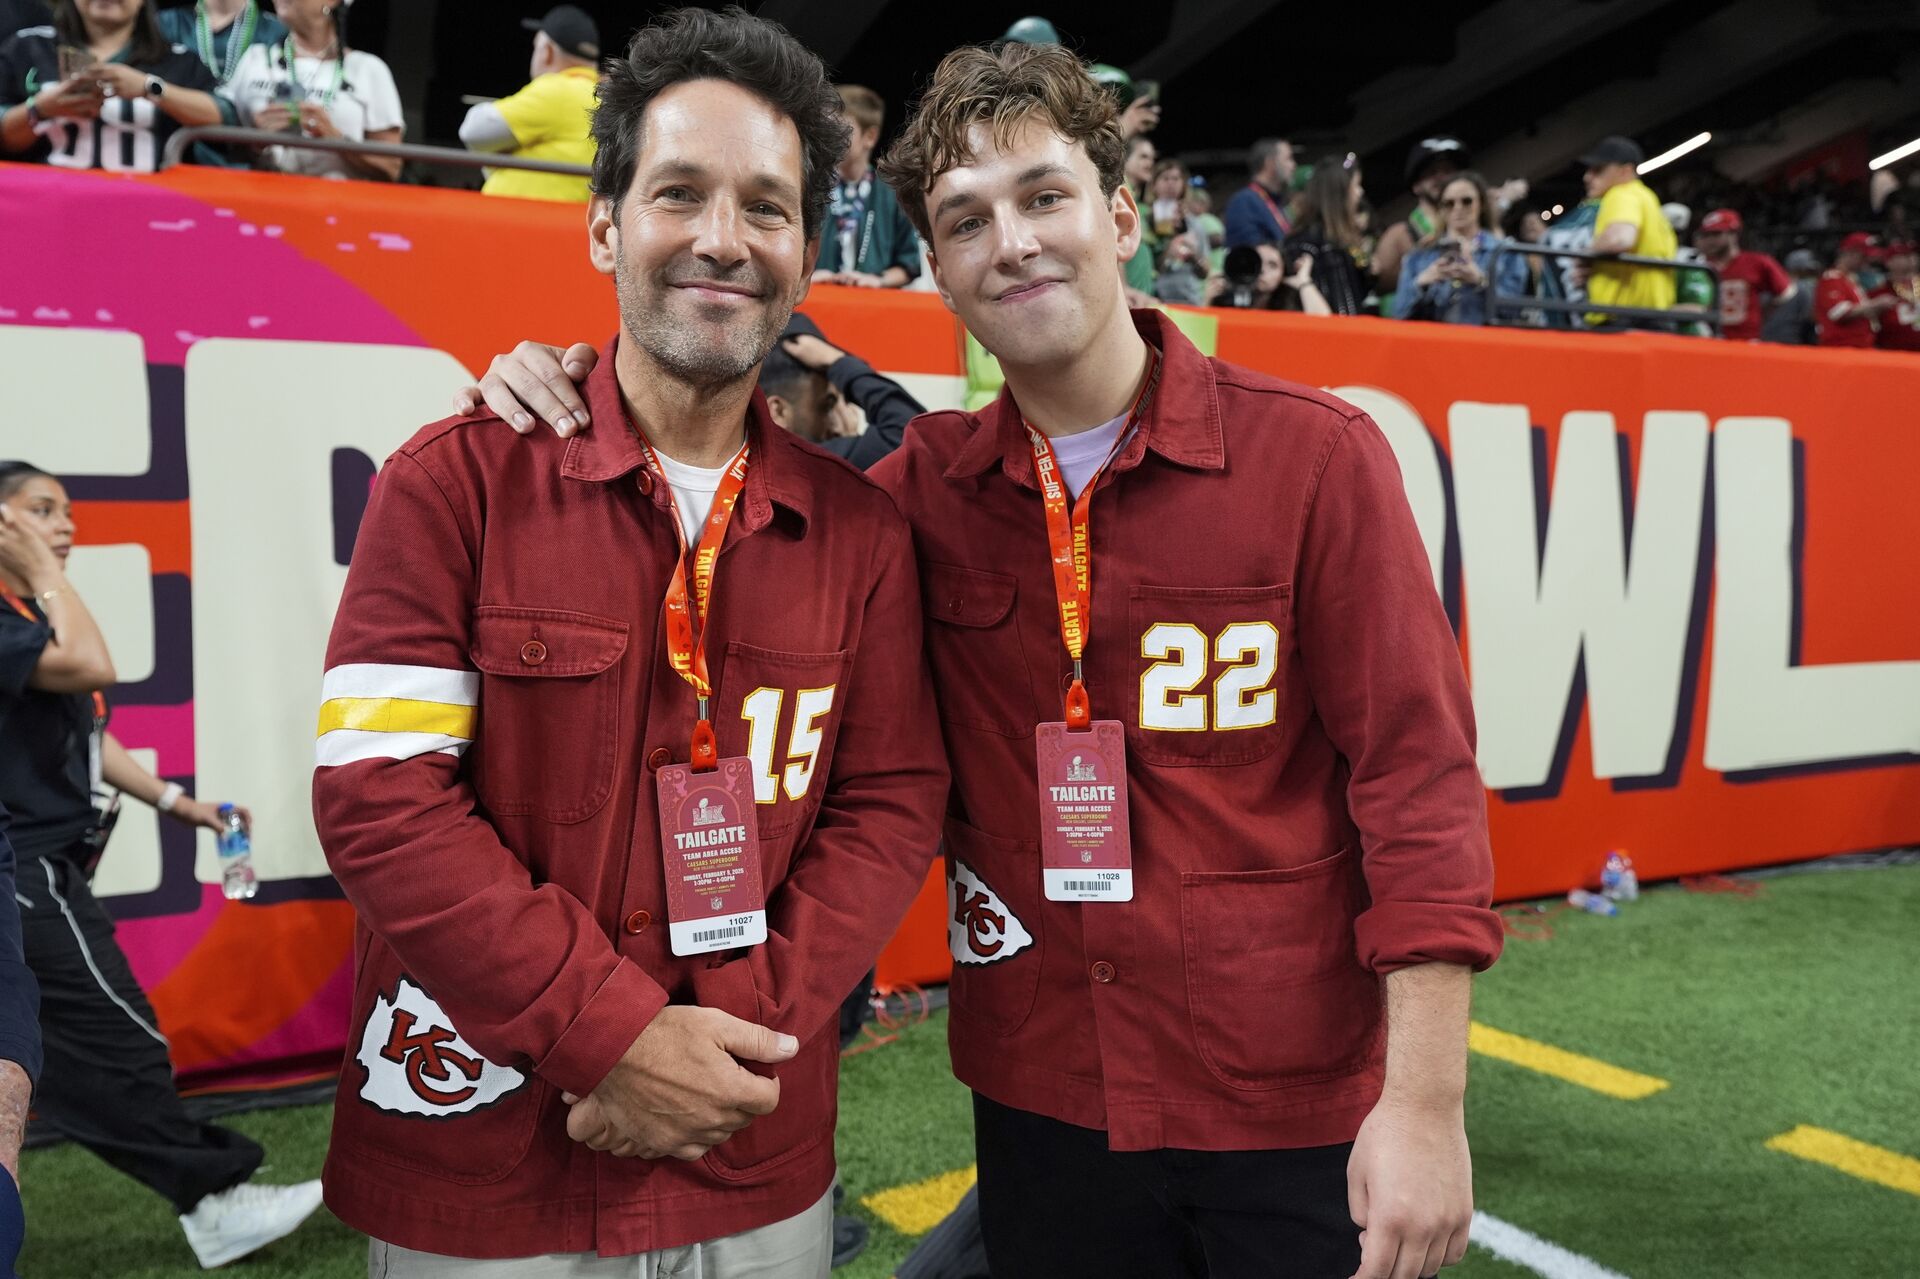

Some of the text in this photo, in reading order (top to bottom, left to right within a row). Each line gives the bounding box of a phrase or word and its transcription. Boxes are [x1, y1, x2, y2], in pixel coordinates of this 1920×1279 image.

[1037, 455, 1062, 499] SUPER
[695, 546, 715, 618] TAILGATE
[1073, 522, 1087, 592] TAILGATE
[1061, 600, 1082, 658] AILGATE
[1139, 621, 1279, 732] 22
[741, 684, 836, 804] 15
[1049, 786, 1116, 802] TAILGATE
[674, 825, 747, 850] TAILGATE
[682, 846, 743, 861] TEAM AREA ACCESS
[686, 860, 709, 868] CAESARS
[709, 856, 739, 865] SUPERDOME
[1097, 873, 1120, 881] 11028
[728, 915, 754, 926] 11027
[955, 881, 1006, 957] KC
[379, 1007, 485, 1107] KC
